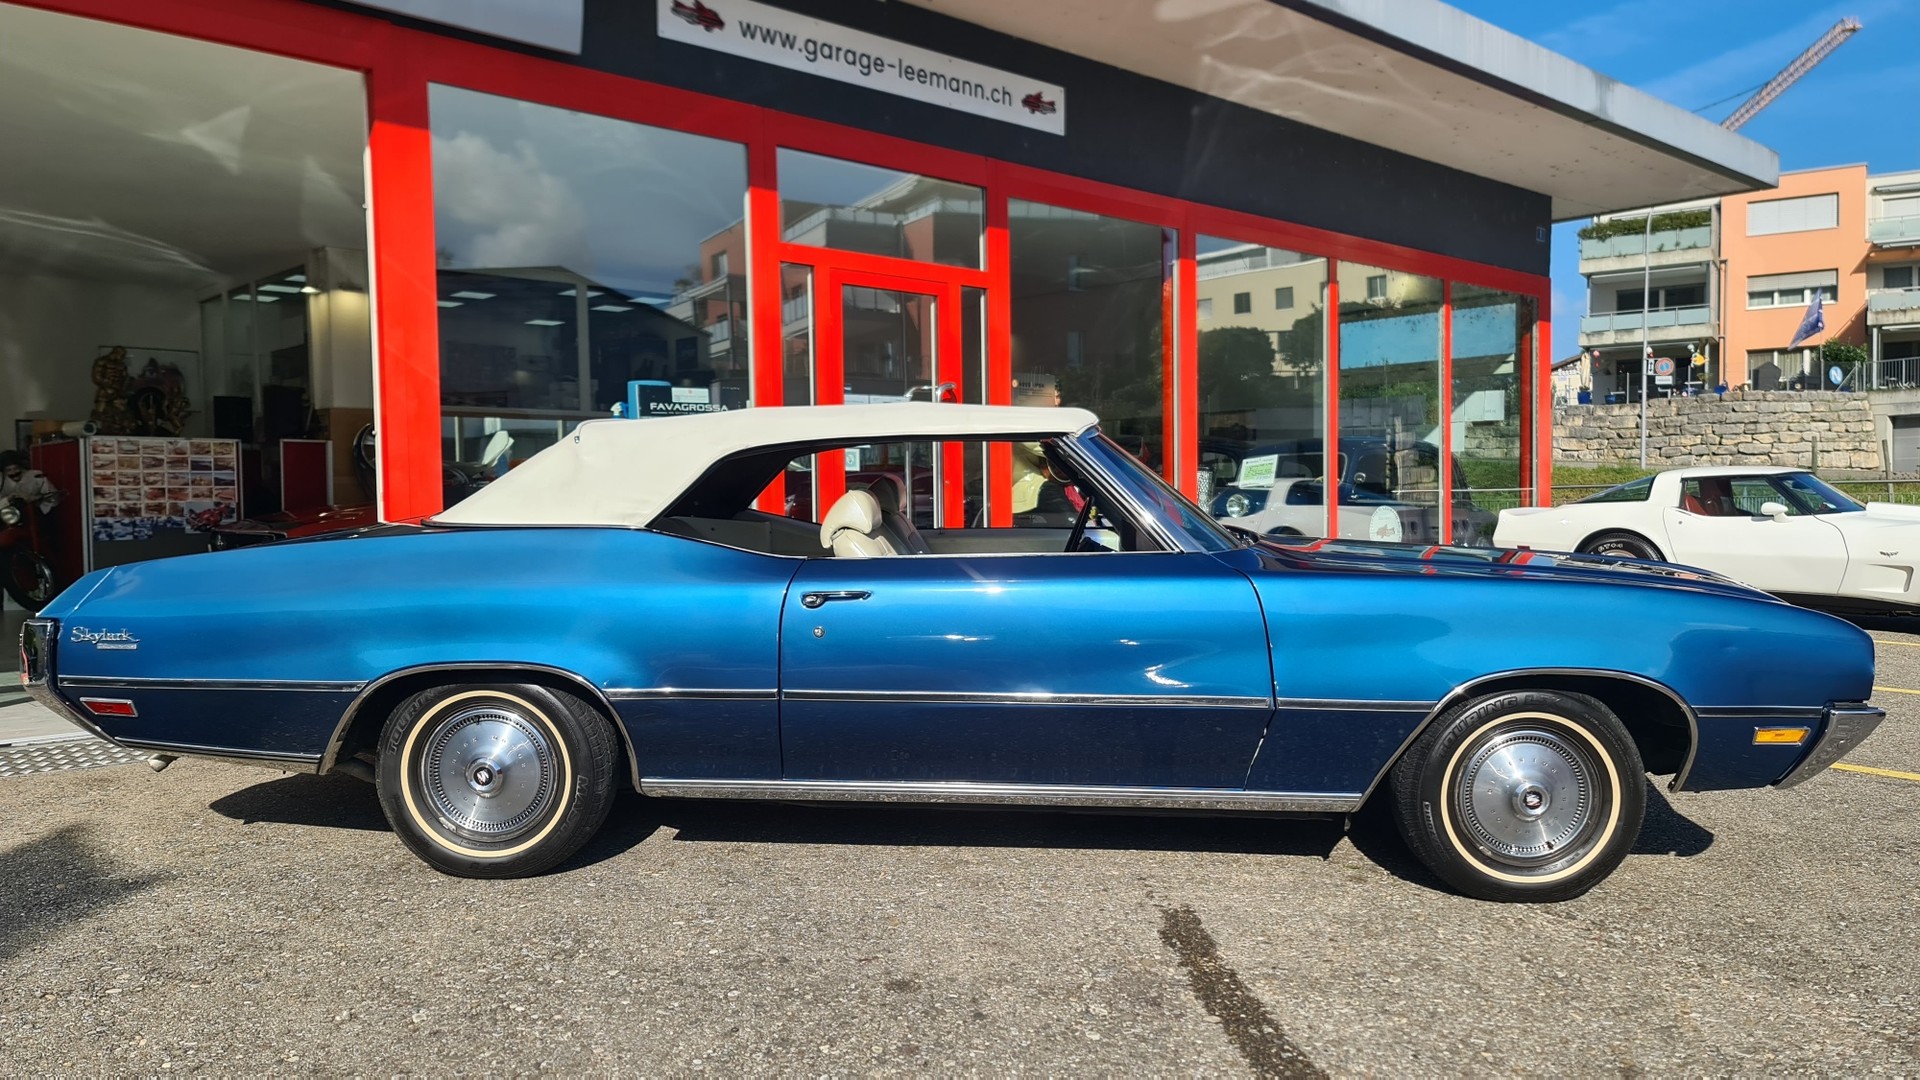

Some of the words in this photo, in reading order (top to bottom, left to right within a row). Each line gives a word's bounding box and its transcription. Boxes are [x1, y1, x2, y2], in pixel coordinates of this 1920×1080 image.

[738, 18, 1013, 107] www.garage-leemann.ch
[649, 402, 728, 412] FAVAGROSSA
[71, 626, 140, 644] Skylark
